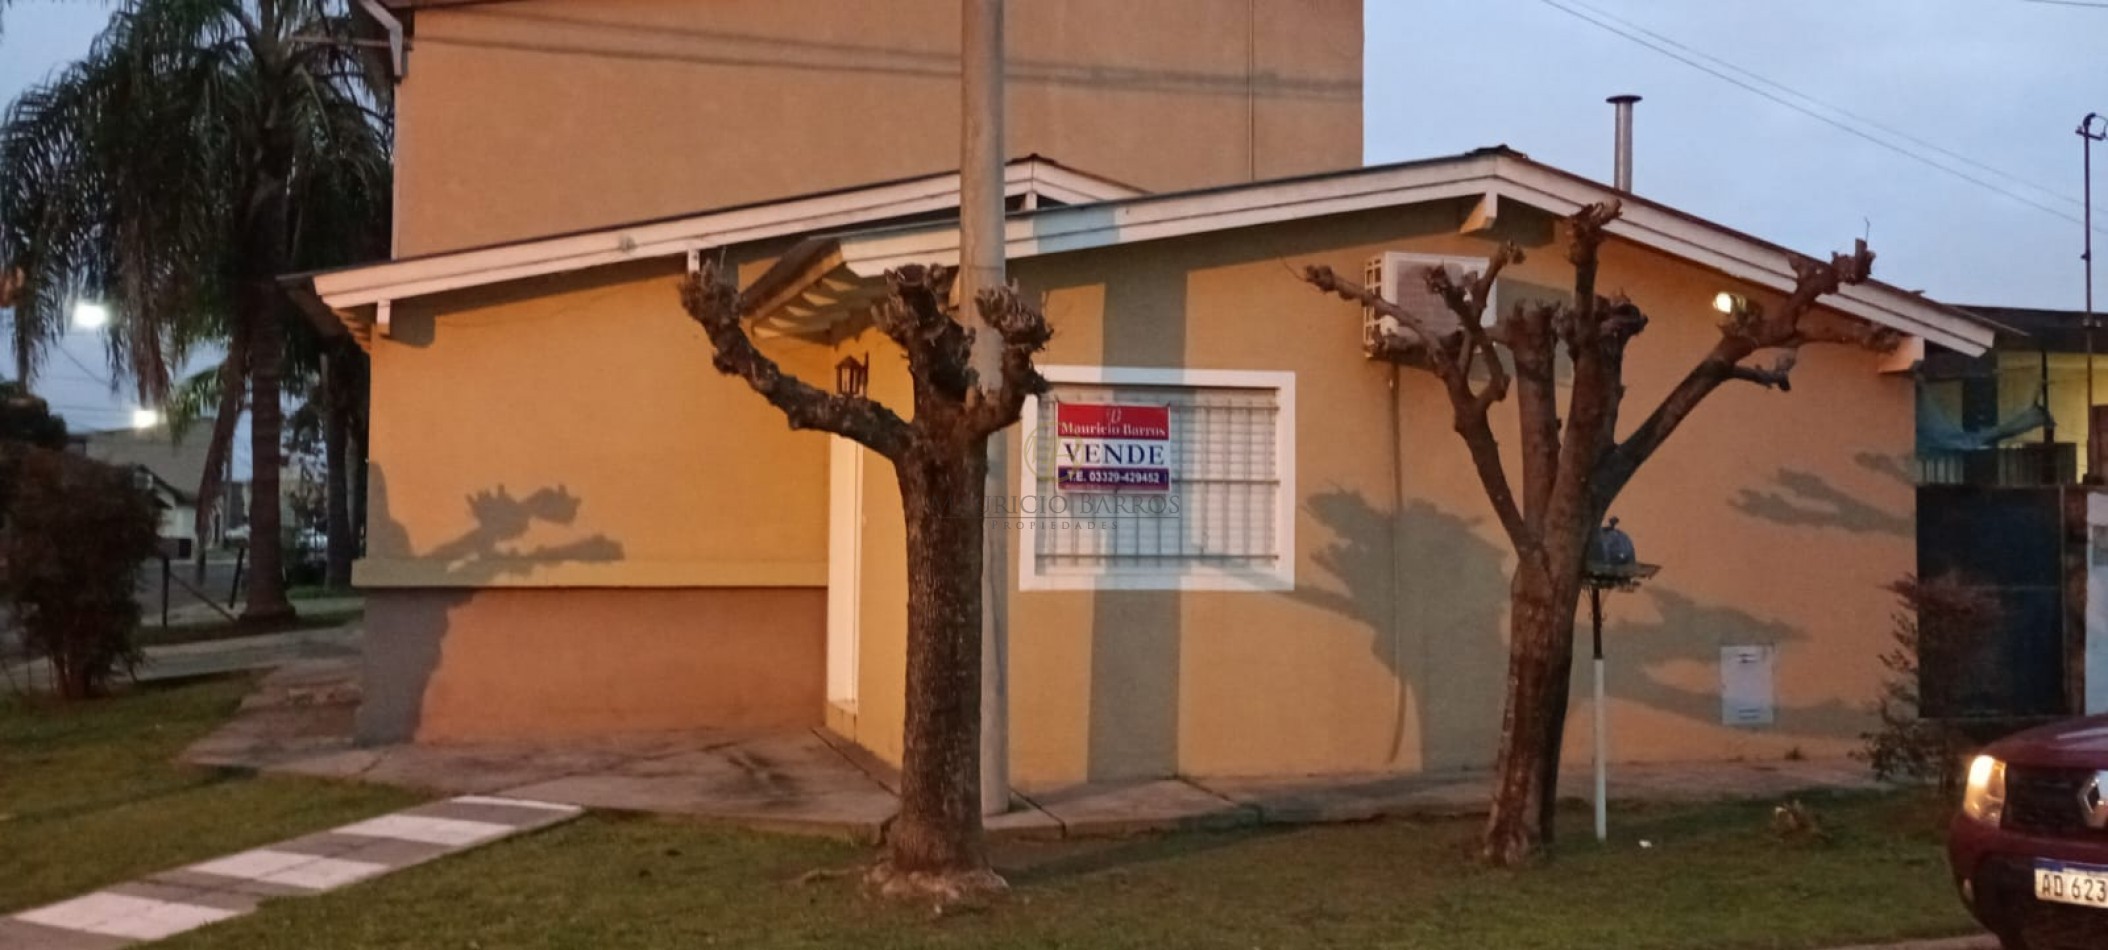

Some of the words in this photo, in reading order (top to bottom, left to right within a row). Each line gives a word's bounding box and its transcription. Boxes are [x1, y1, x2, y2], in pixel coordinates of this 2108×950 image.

[1061, 422, 1120, 435] Mauricio
[1123, 423, 1166, 436] Barros
[1064, 443, 1165, 465] VENDE
[2042, 874, 2064, 897] AD
[2071, 877, 2107, 903] 623
